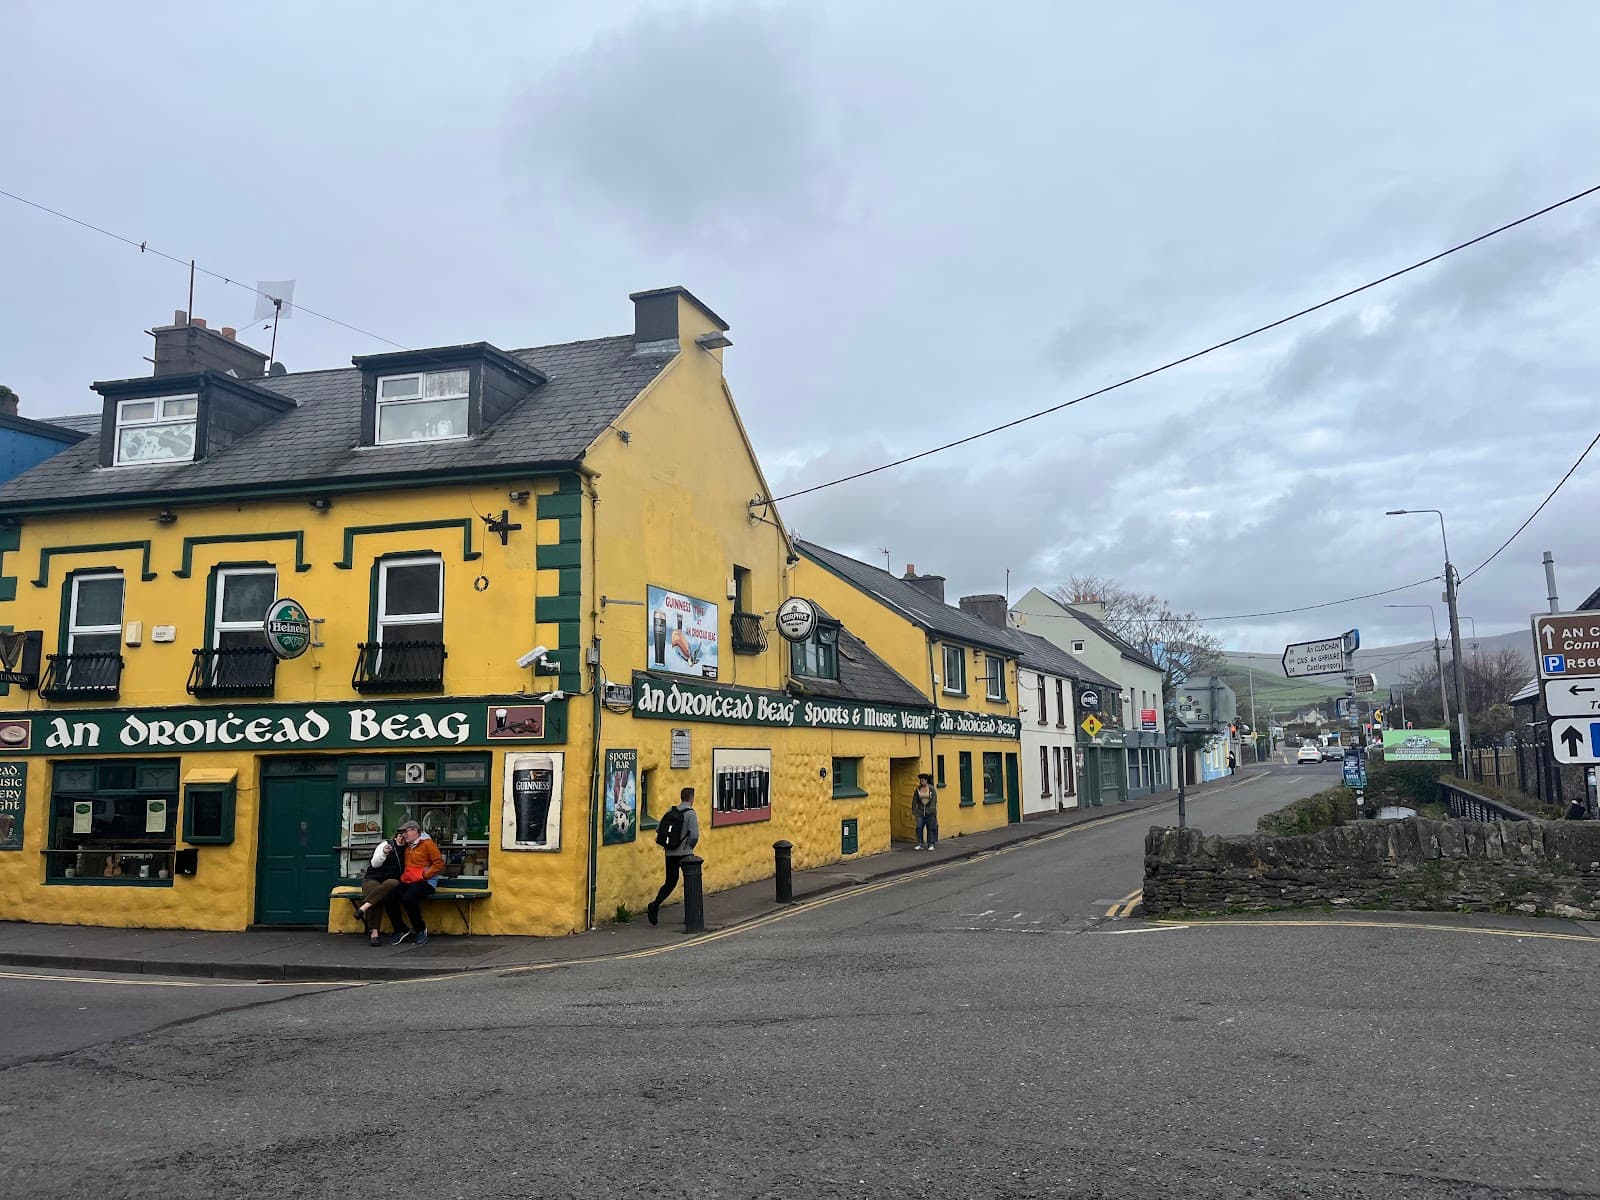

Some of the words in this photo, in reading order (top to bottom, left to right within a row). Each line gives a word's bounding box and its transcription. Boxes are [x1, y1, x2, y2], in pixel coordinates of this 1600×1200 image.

[665, 596, 691, 613] GUINNESS
[1562, 627, 1584, 639] AN
[1548, 657, 1560, 672] P
[852, 708, 861, 725] &
[615, 760, 630, 769] BAR
[515, 781, 550, 791] GUINNESS
